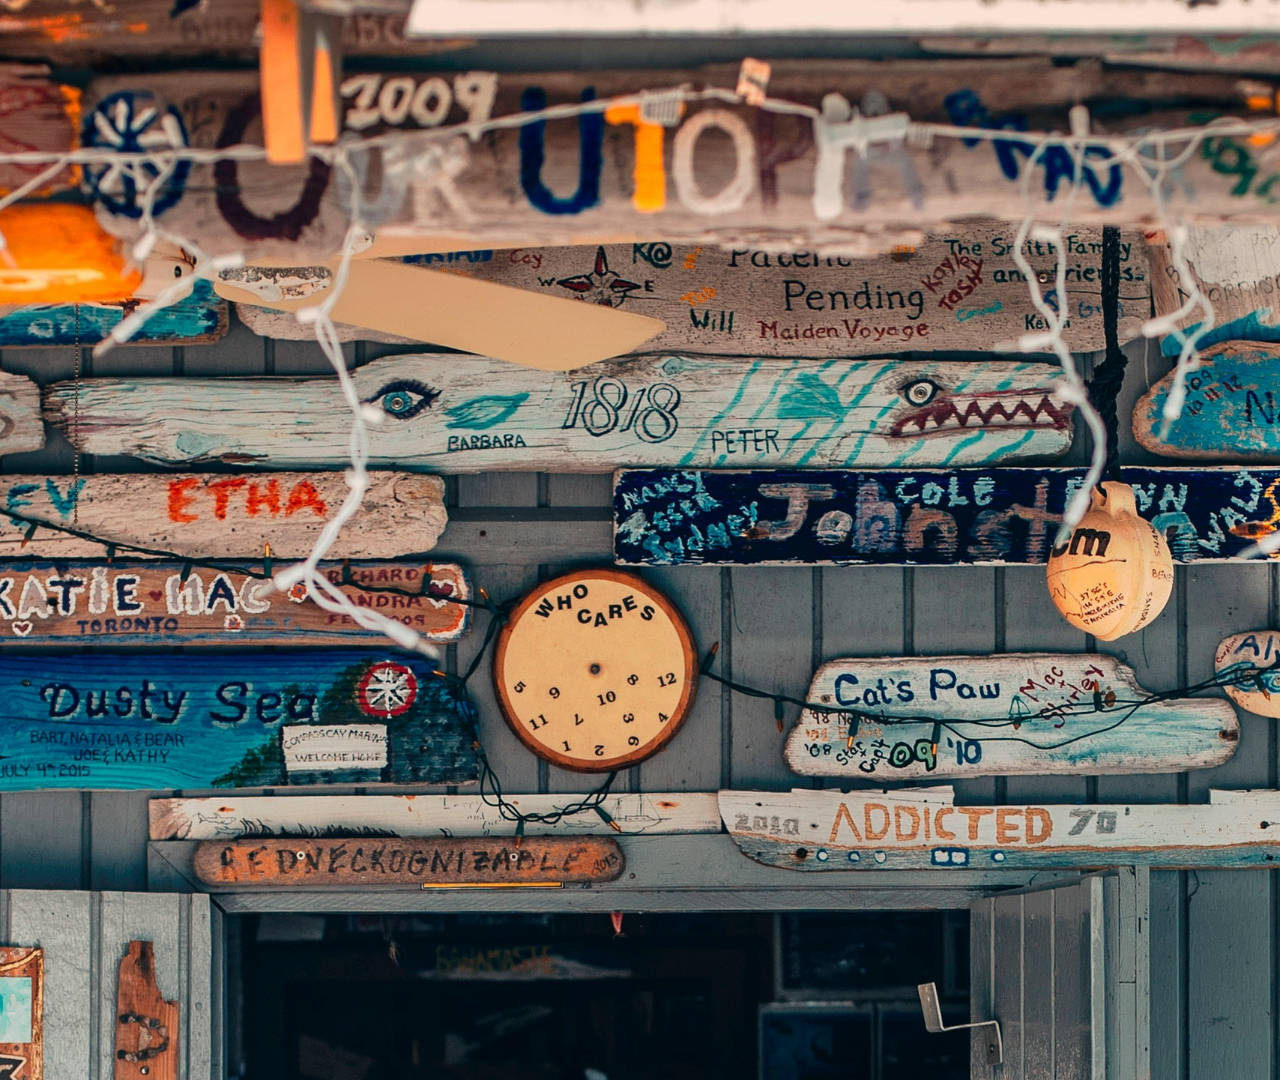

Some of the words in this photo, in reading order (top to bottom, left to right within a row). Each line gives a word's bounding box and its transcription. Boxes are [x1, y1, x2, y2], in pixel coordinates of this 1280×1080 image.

[340, 72, 497, 132] 2009
[944, 238, 983, 256] The
[783, 278, 925, 320] Pending
[690, 308, 734, 334] Will
[757, 319, 841, 340] Maiden
[844, 317, 931, 341] Voyage
[561, 375, 682, 444] 1818
[446, 432, 527, 452] BARBARA
[710, 428, 781, 456] PETER
[327, 567, 420, 584] RCHARD
[535, 583, 589, 621] WHO
[576, 594, 656, 628] CARES
[76, 616, 180, 634] TORONTO
[657, 671, 677, 689] 12
[833, 672, 916, 708] Cat's
[928, 668, 1001, 702] Paw
[38, 678, 190, 726] Dusty
[208, 682, 319, 726] Sea
[597, 689, 617, 707] 10
[528, 713, 549, 731] 11
[70, 731, 132, 747] NATALIA
[144, 732, 186, 748] BEAR
[113, 749, 171, 764] KATHY
[294, 752, 350, 763] WELCOME
[351, 752, 382, 763] HOME
[58, 764, 91, 778] 2015
[828, 800, 1055, 846] ADDICTED
